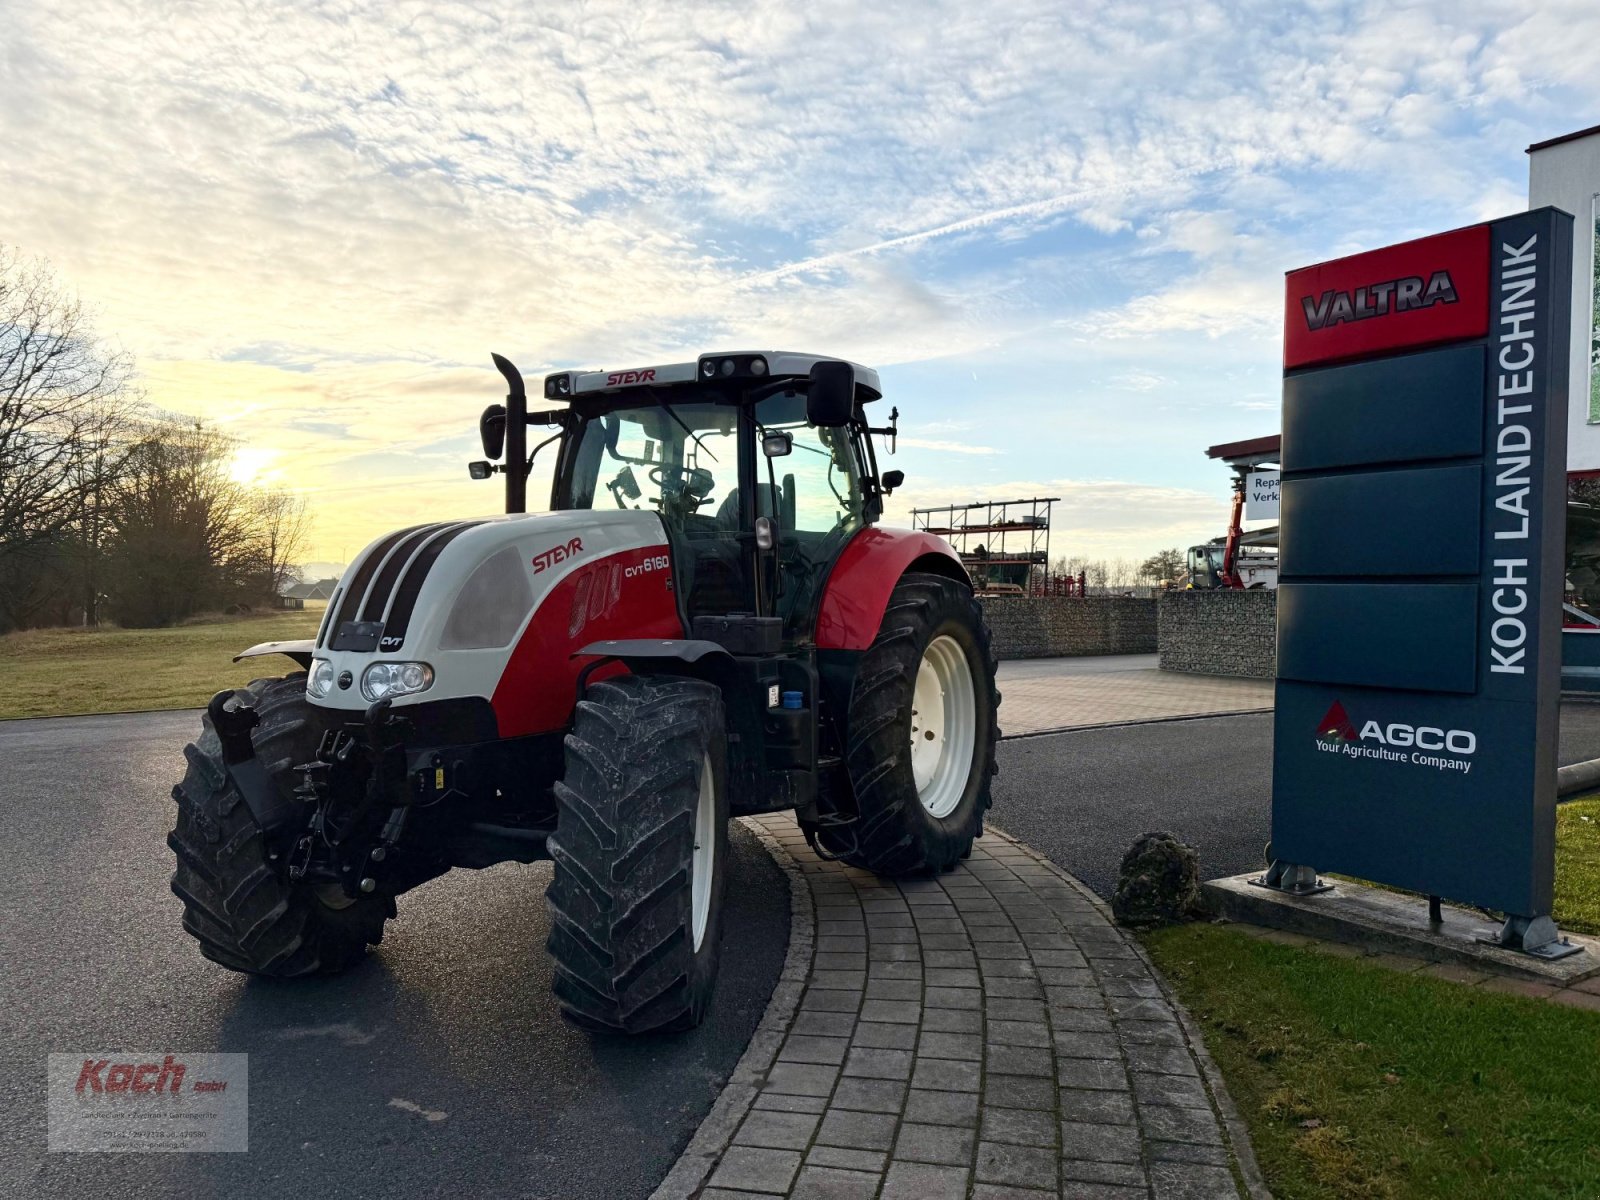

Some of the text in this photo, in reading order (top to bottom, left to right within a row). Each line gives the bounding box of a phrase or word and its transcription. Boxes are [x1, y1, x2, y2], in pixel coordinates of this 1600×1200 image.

[1301, 270, 1459, 331] VALTRA
[606, 369, 656, 386] STEYR
[1490, 233, 1538, 674] KOCH LANDTECHNIK
[1253, 492, 1280, 502] Verk
[532, 537, 584, 574] STEYR
[380, 637, 403, 646] CVT
[1359, 720, 1476, 755] AGCO
[1316, 739, 1471, 774] Your Agriculture Company
